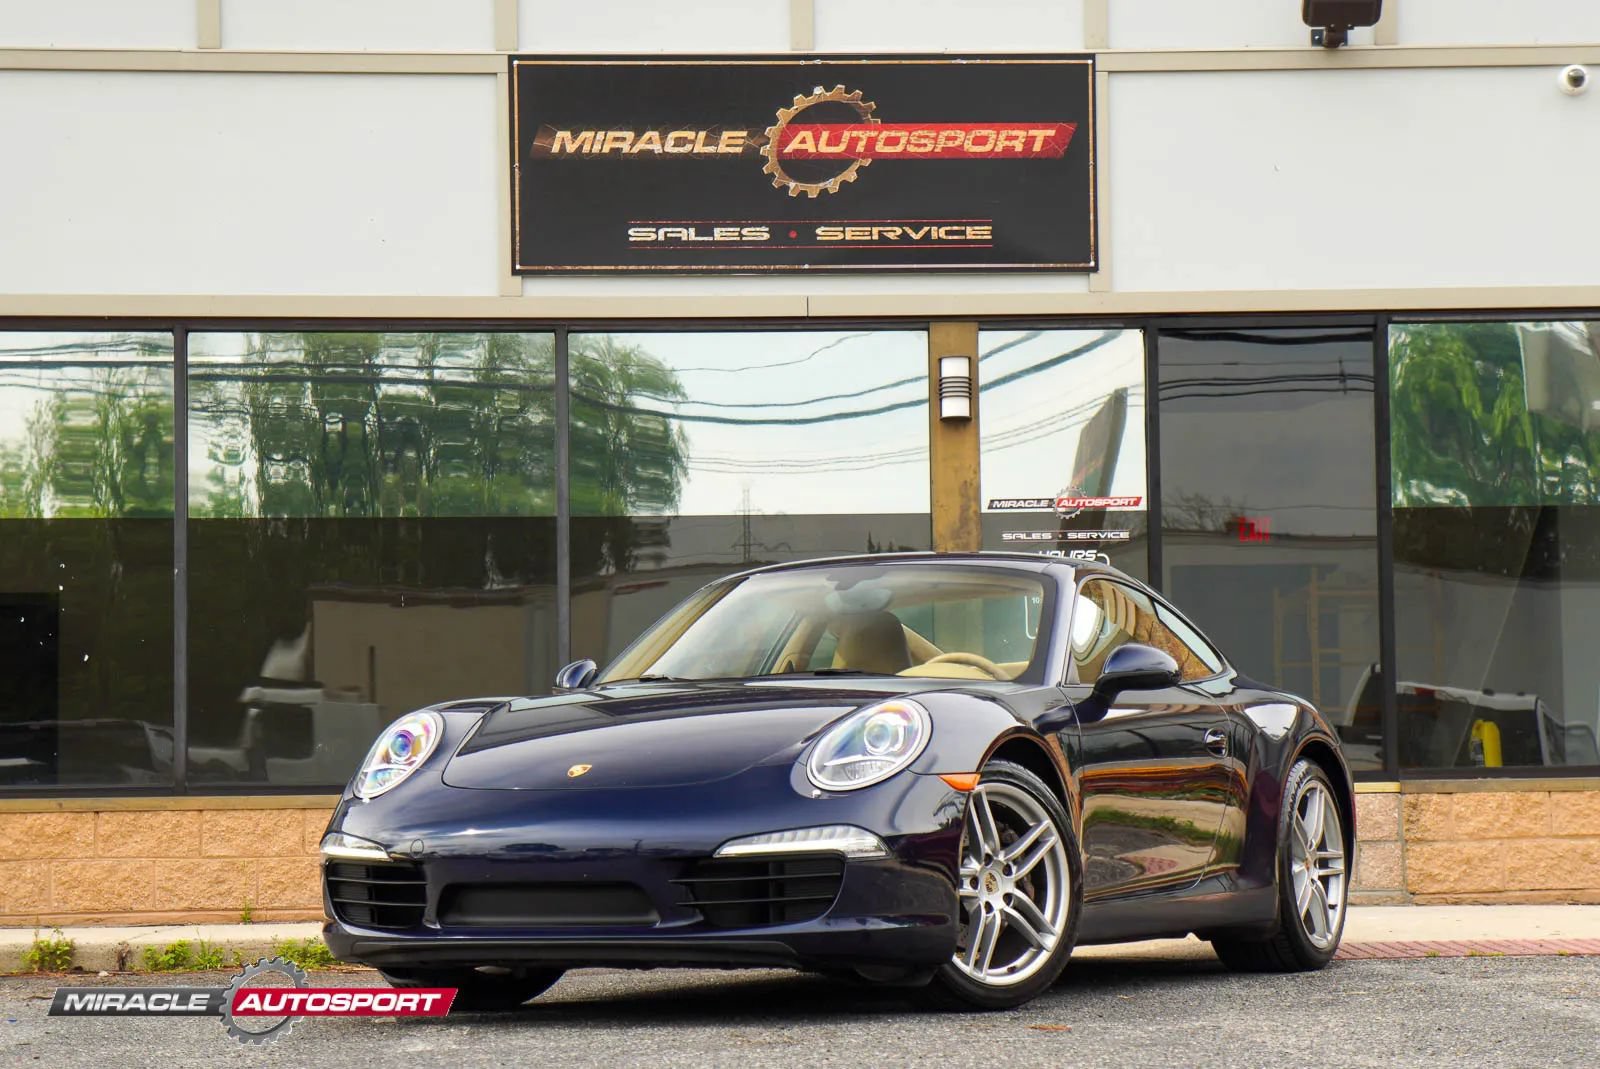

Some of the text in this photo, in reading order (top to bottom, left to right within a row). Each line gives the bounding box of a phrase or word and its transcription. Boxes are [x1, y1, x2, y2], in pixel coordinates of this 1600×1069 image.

[551, 128, 1058, 154] MIRACLE AUTOSPORT
[627, 224, 993, 242] SALES SERVICE
[992, 497, 1137, 508] MIRACLE AUTOSPORT
[1002, 531, 1130, 541] SALES SERVICE
